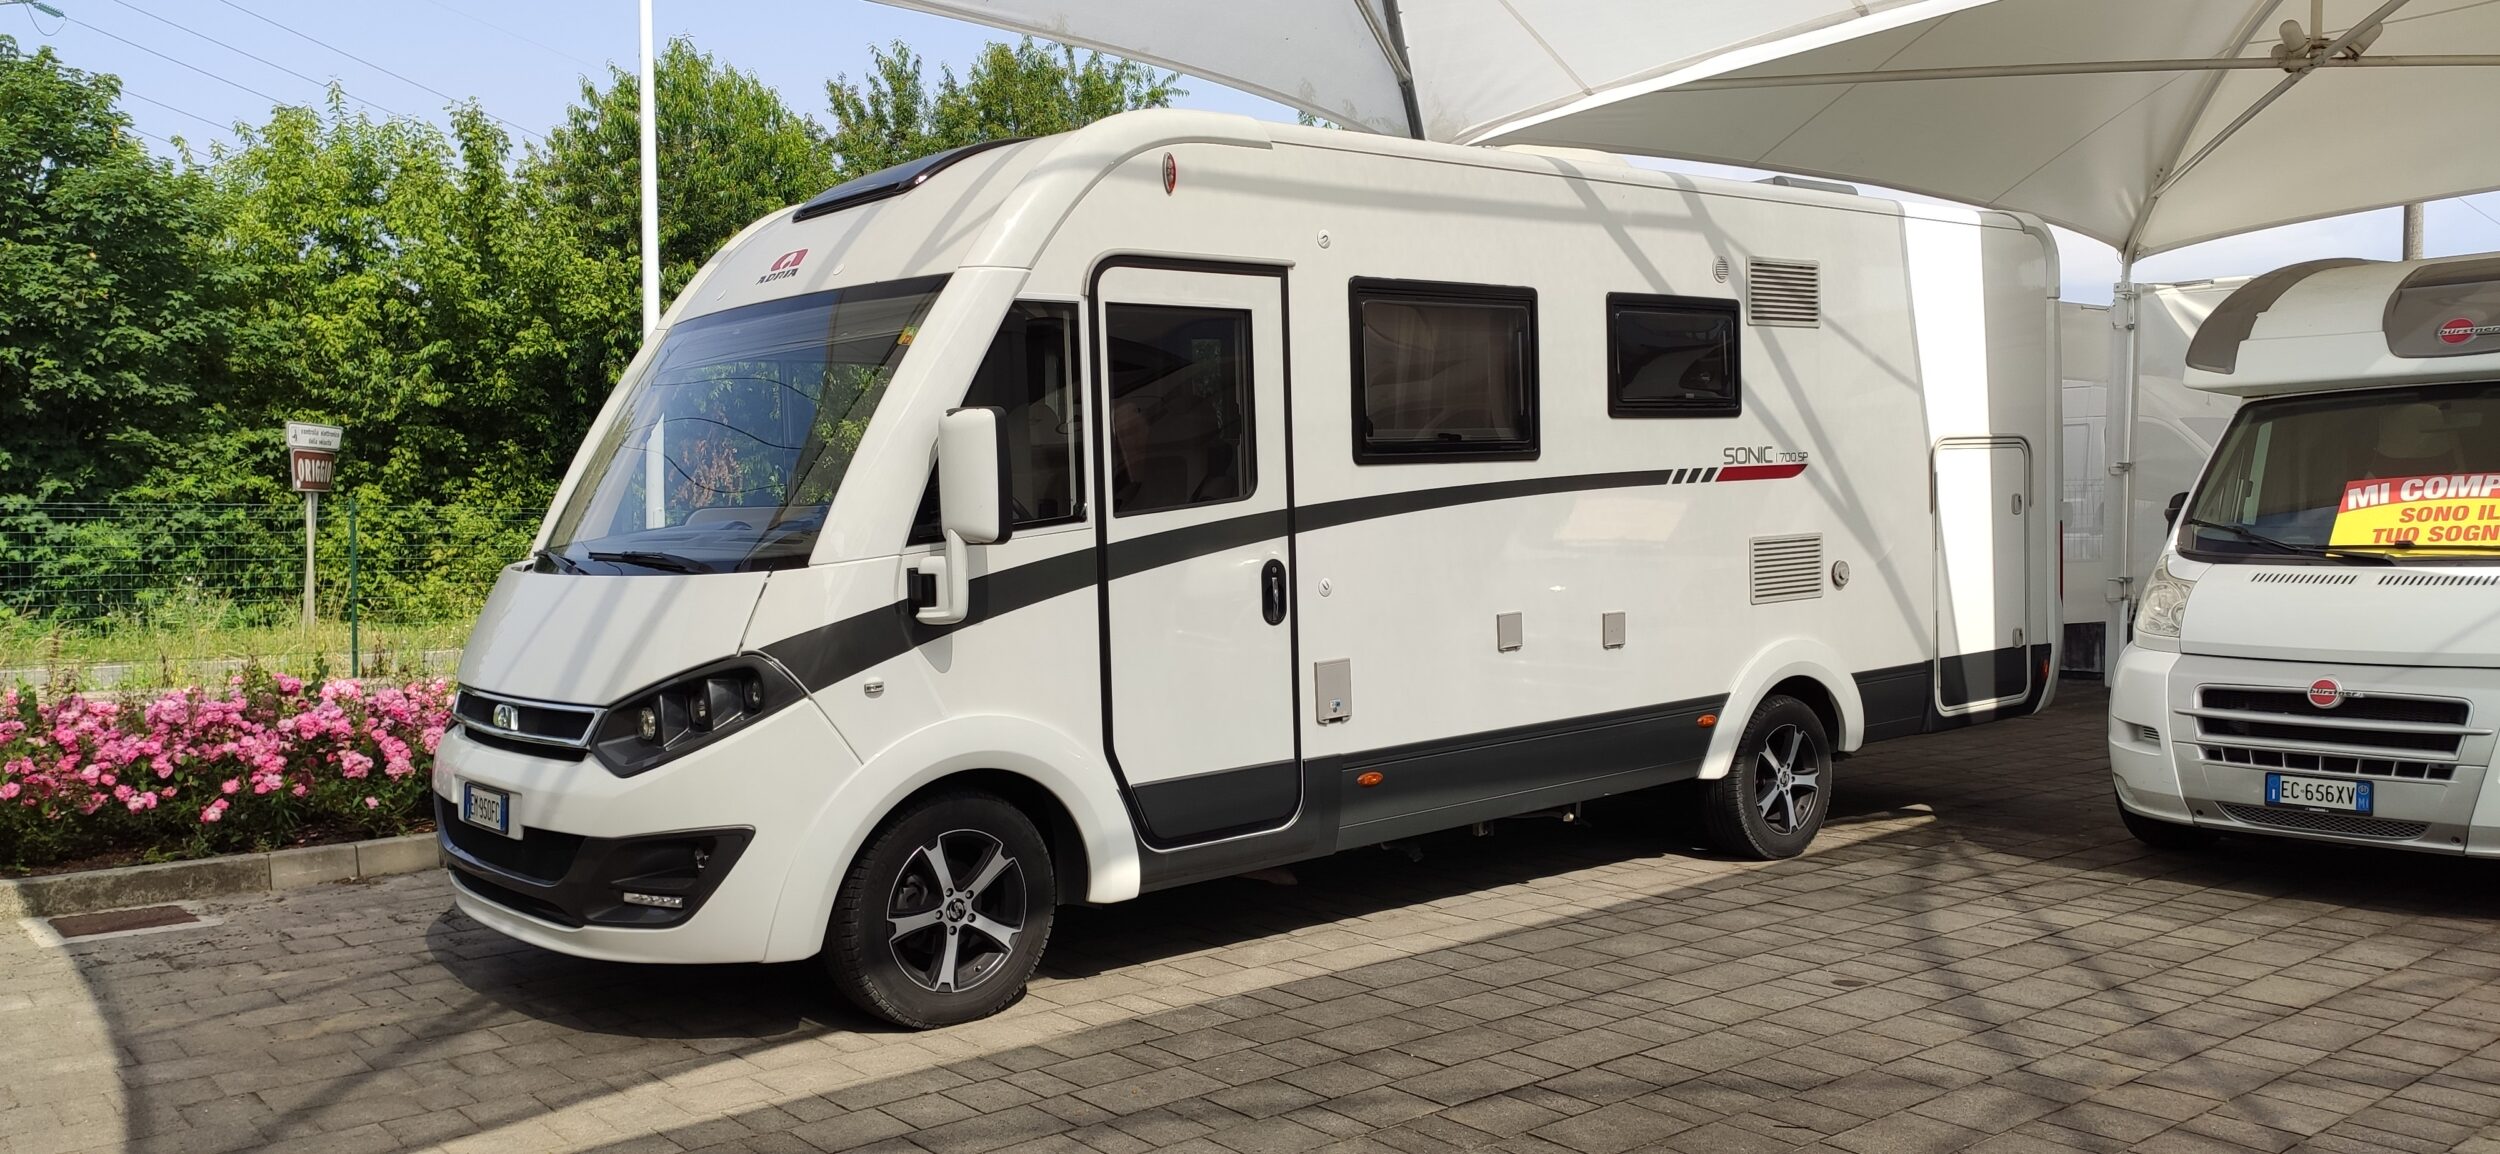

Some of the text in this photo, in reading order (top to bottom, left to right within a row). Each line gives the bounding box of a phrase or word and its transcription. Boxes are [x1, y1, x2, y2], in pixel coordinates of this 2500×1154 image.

[755, 268, 799, 286] ADRIA
[1723, 445, 1774, 465] SONIC
[1797, 451, 1809, 462] SP
[297, 457, 333, 484] ORIGGIO
[2347, 474, 2500, 510] MI COMP
[2399, 504, 2500, 523] SONO IL
[2372, 526, 2420, 544] TUO
